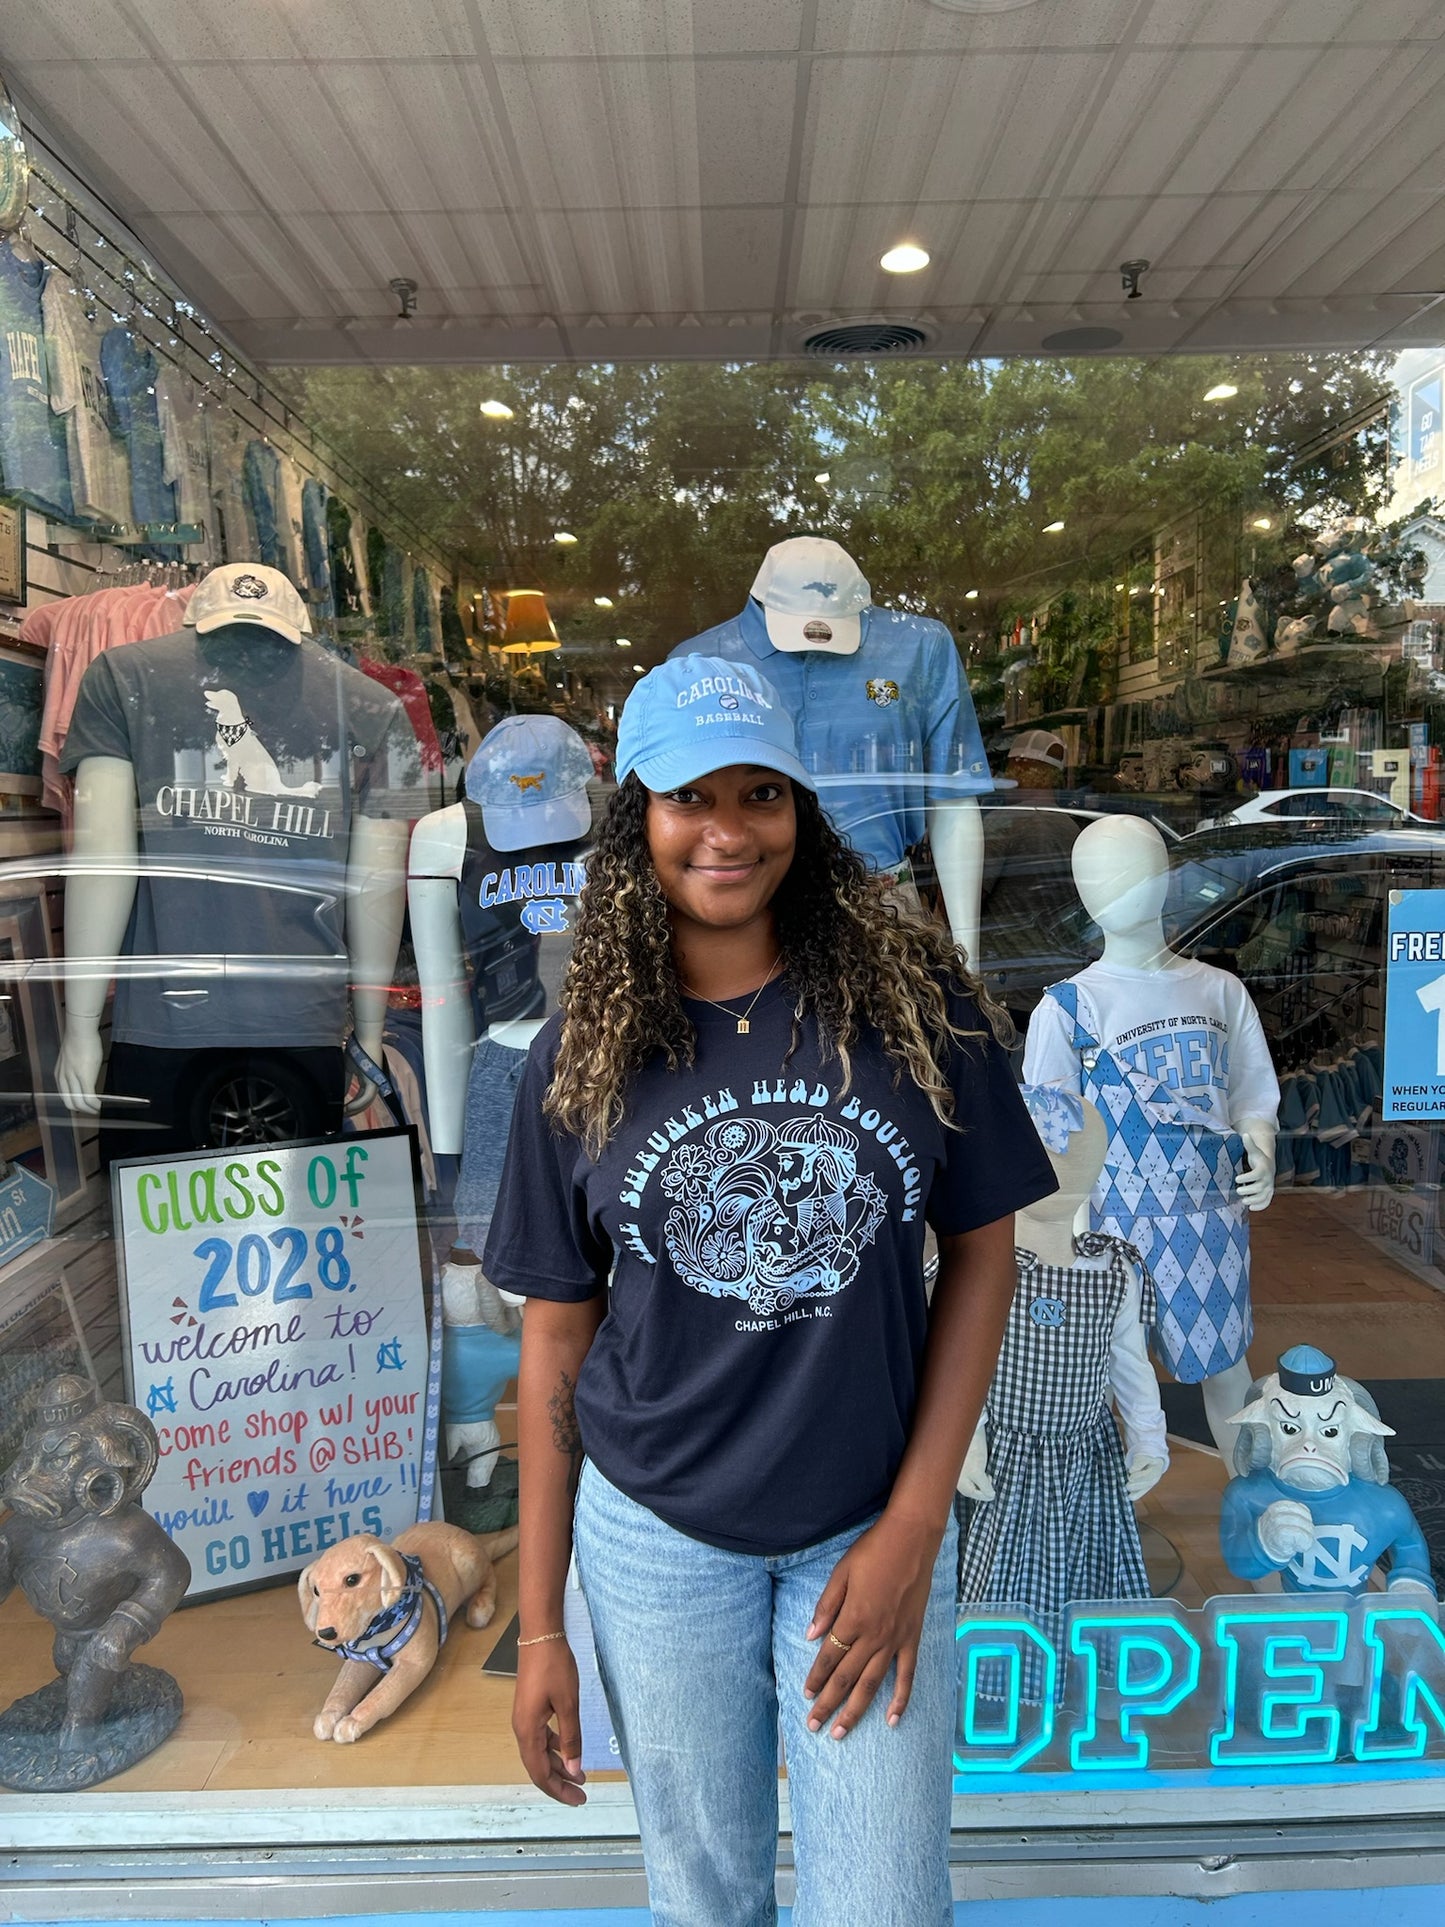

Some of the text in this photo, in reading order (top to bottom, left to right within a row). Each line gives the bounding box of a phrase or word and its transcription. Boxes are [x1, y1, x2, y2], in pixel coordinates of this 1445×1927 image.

[695, 712, 765, 726] BASEBALL
[156, 785, 335, 839] CHAPEL HILL
[204, 826, 241, 838] NORTH
[1391, 931, 1445, 961] FRE
[1116, 1020, 1166, 1046] UNIVERSITY
[1168, 1017, 1179, 1028] OF
[1180, 1015, 1207, 1026] NORTH
[1392, 1086, 1428, 1095] WHEN
[619, 1088, 740, 1209] SHRUNKEN
[752, 1078, 830, 1108] HEAD
[138, 1304, 384, 1364] welcome to
[735, 1306, 833, 1332] CHAPEL HILL, N.C.
[43, 1403, 83, 1423] UNC
[158, 1419, 231, 1457] come
[245, 1409, 308, 1443] shop
[365, 1392, 420, 1435] your
[182, 1447, 297, 1491] friends
[281, 1483, 310, 1514] it
[205, 1505, 383, 1575] GO HEELS
